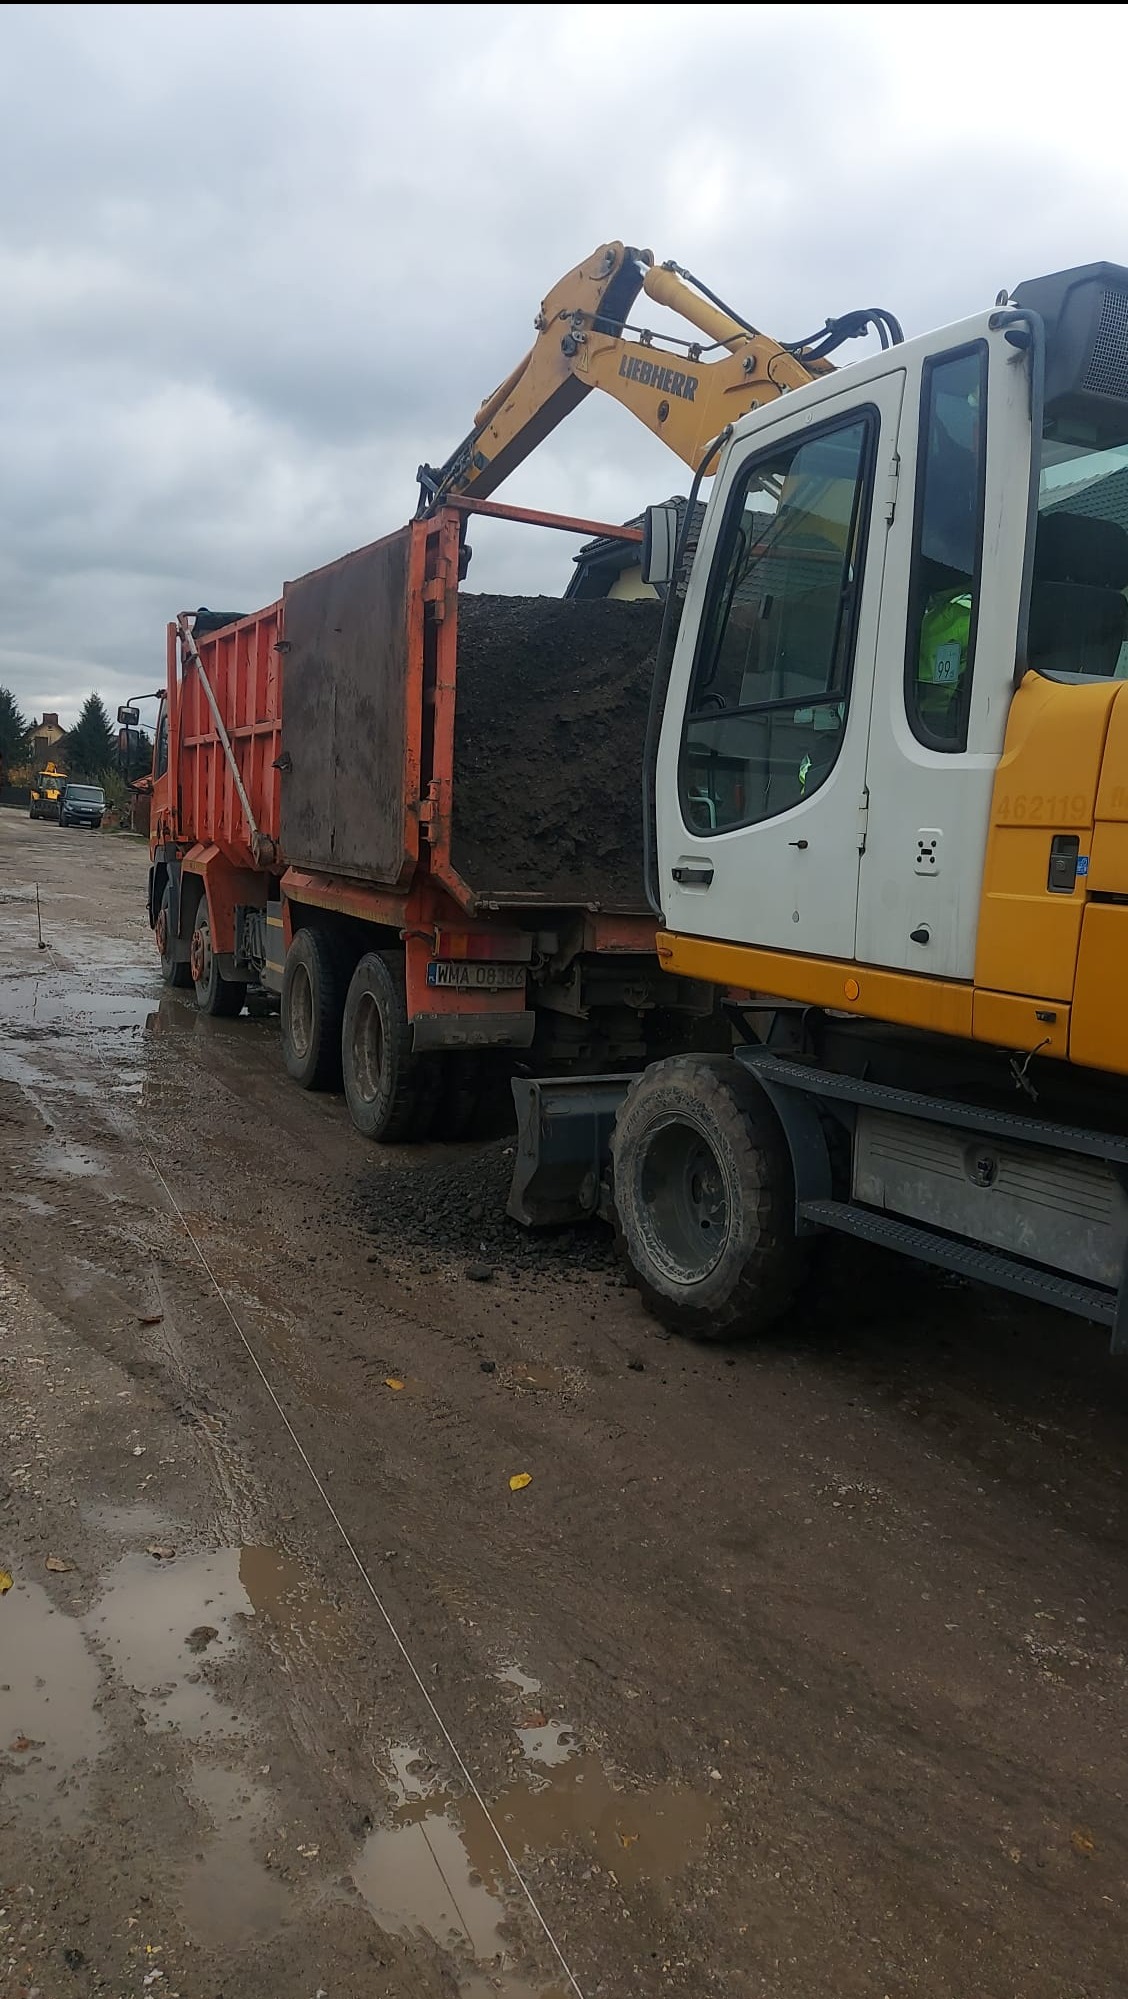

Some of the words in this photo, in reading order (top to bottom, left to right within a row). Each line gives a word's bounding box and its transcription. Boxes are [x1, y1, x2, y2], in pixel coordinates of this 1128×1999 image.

[618, 354, 699, 402] LIEBHERR
[937, 660, 951, 678] 99
[997, 794, 1087, 821] 462119
[438, 965, 469, 985] WMA
